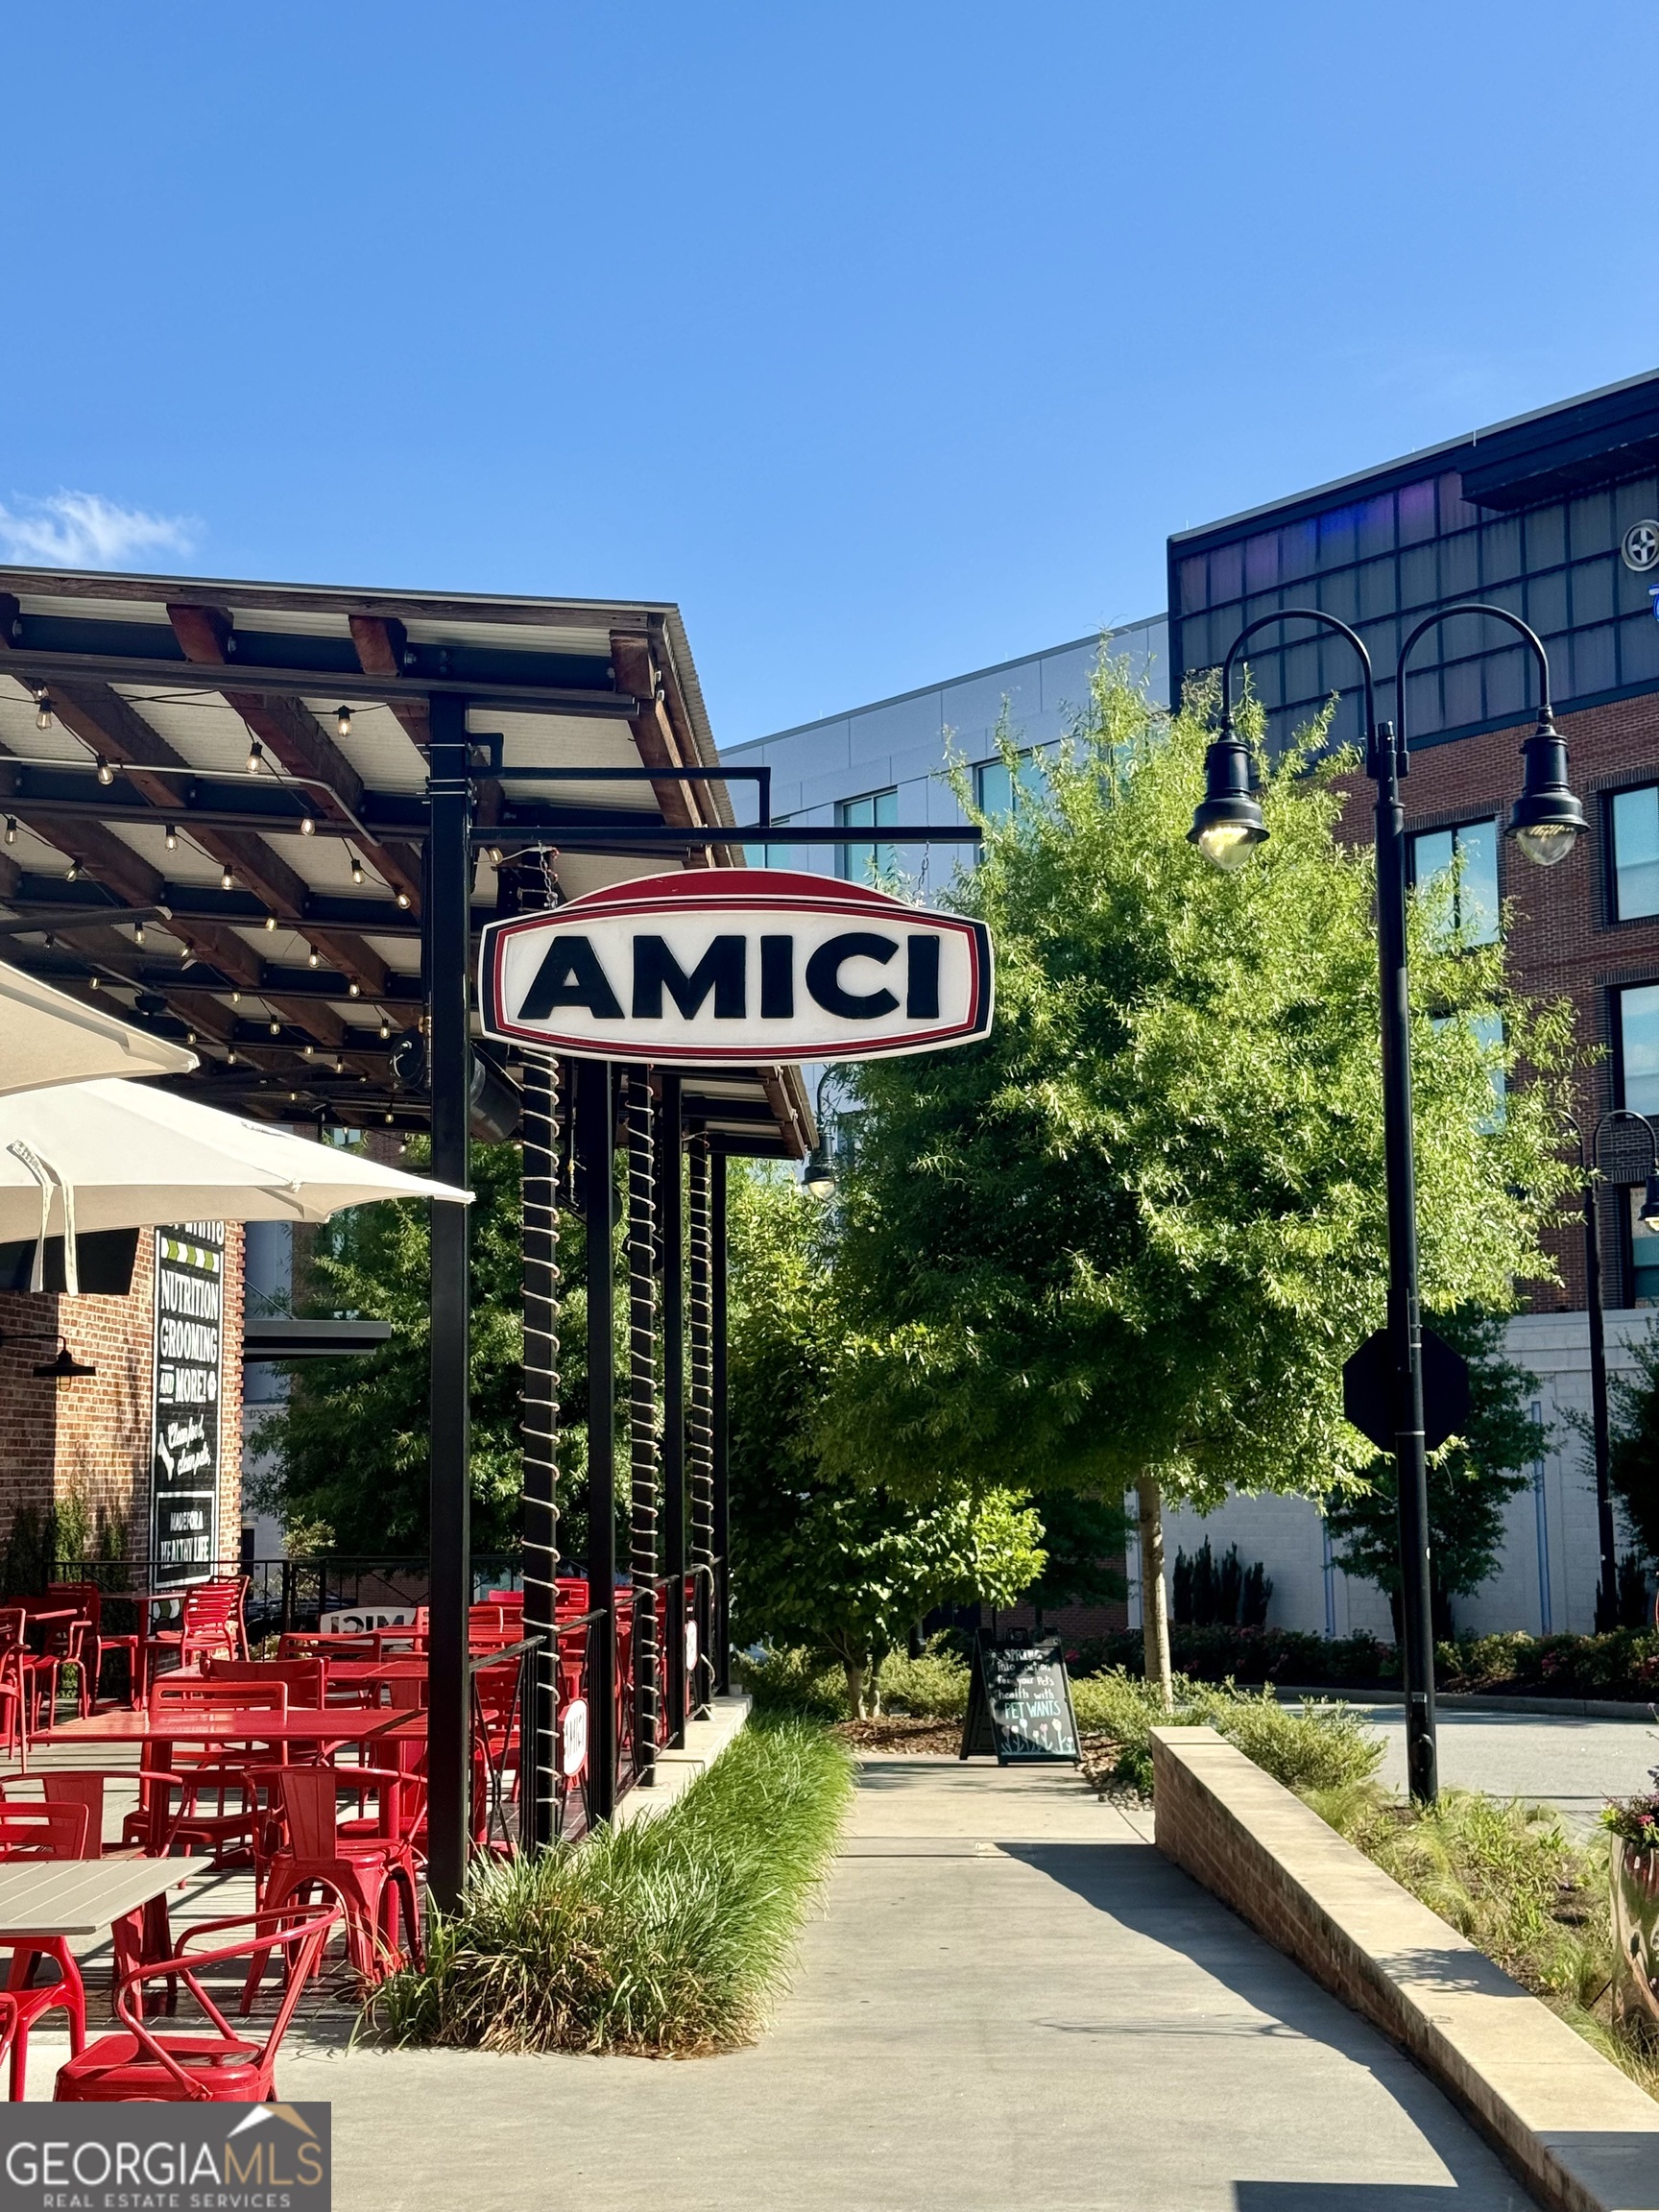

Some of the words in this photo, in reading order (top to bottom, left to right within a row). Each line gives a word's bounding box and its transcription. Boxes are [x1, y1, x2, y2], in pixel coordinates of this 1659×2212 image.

[517, 932, 940, 1021] AMICI
[160, 1268, 219, 1320] NUTRITION
[160, 1317, 218, 1363] GROOMING
[159, 1372, 175, 1394] AND
[175, 1367, 207, 1403] MORE!
[170, 1511, 187, 1531] MADE
[187, 1511, 198, 1530] FOR
[198, 1510, 204, 1529] A
[160, 1538, 193, 1570] HEALTHY
[194, 1535, 209, 1562] LIFE
[1003, 1648, 1043, 1661] SPRING
[998, 1688, 1029, 1699] health
[1034, 1688, 1055, 1699] with
[1005, 1701, 1024, 1719] PET
[1026, 1700, 1061, 1718] WANTS
